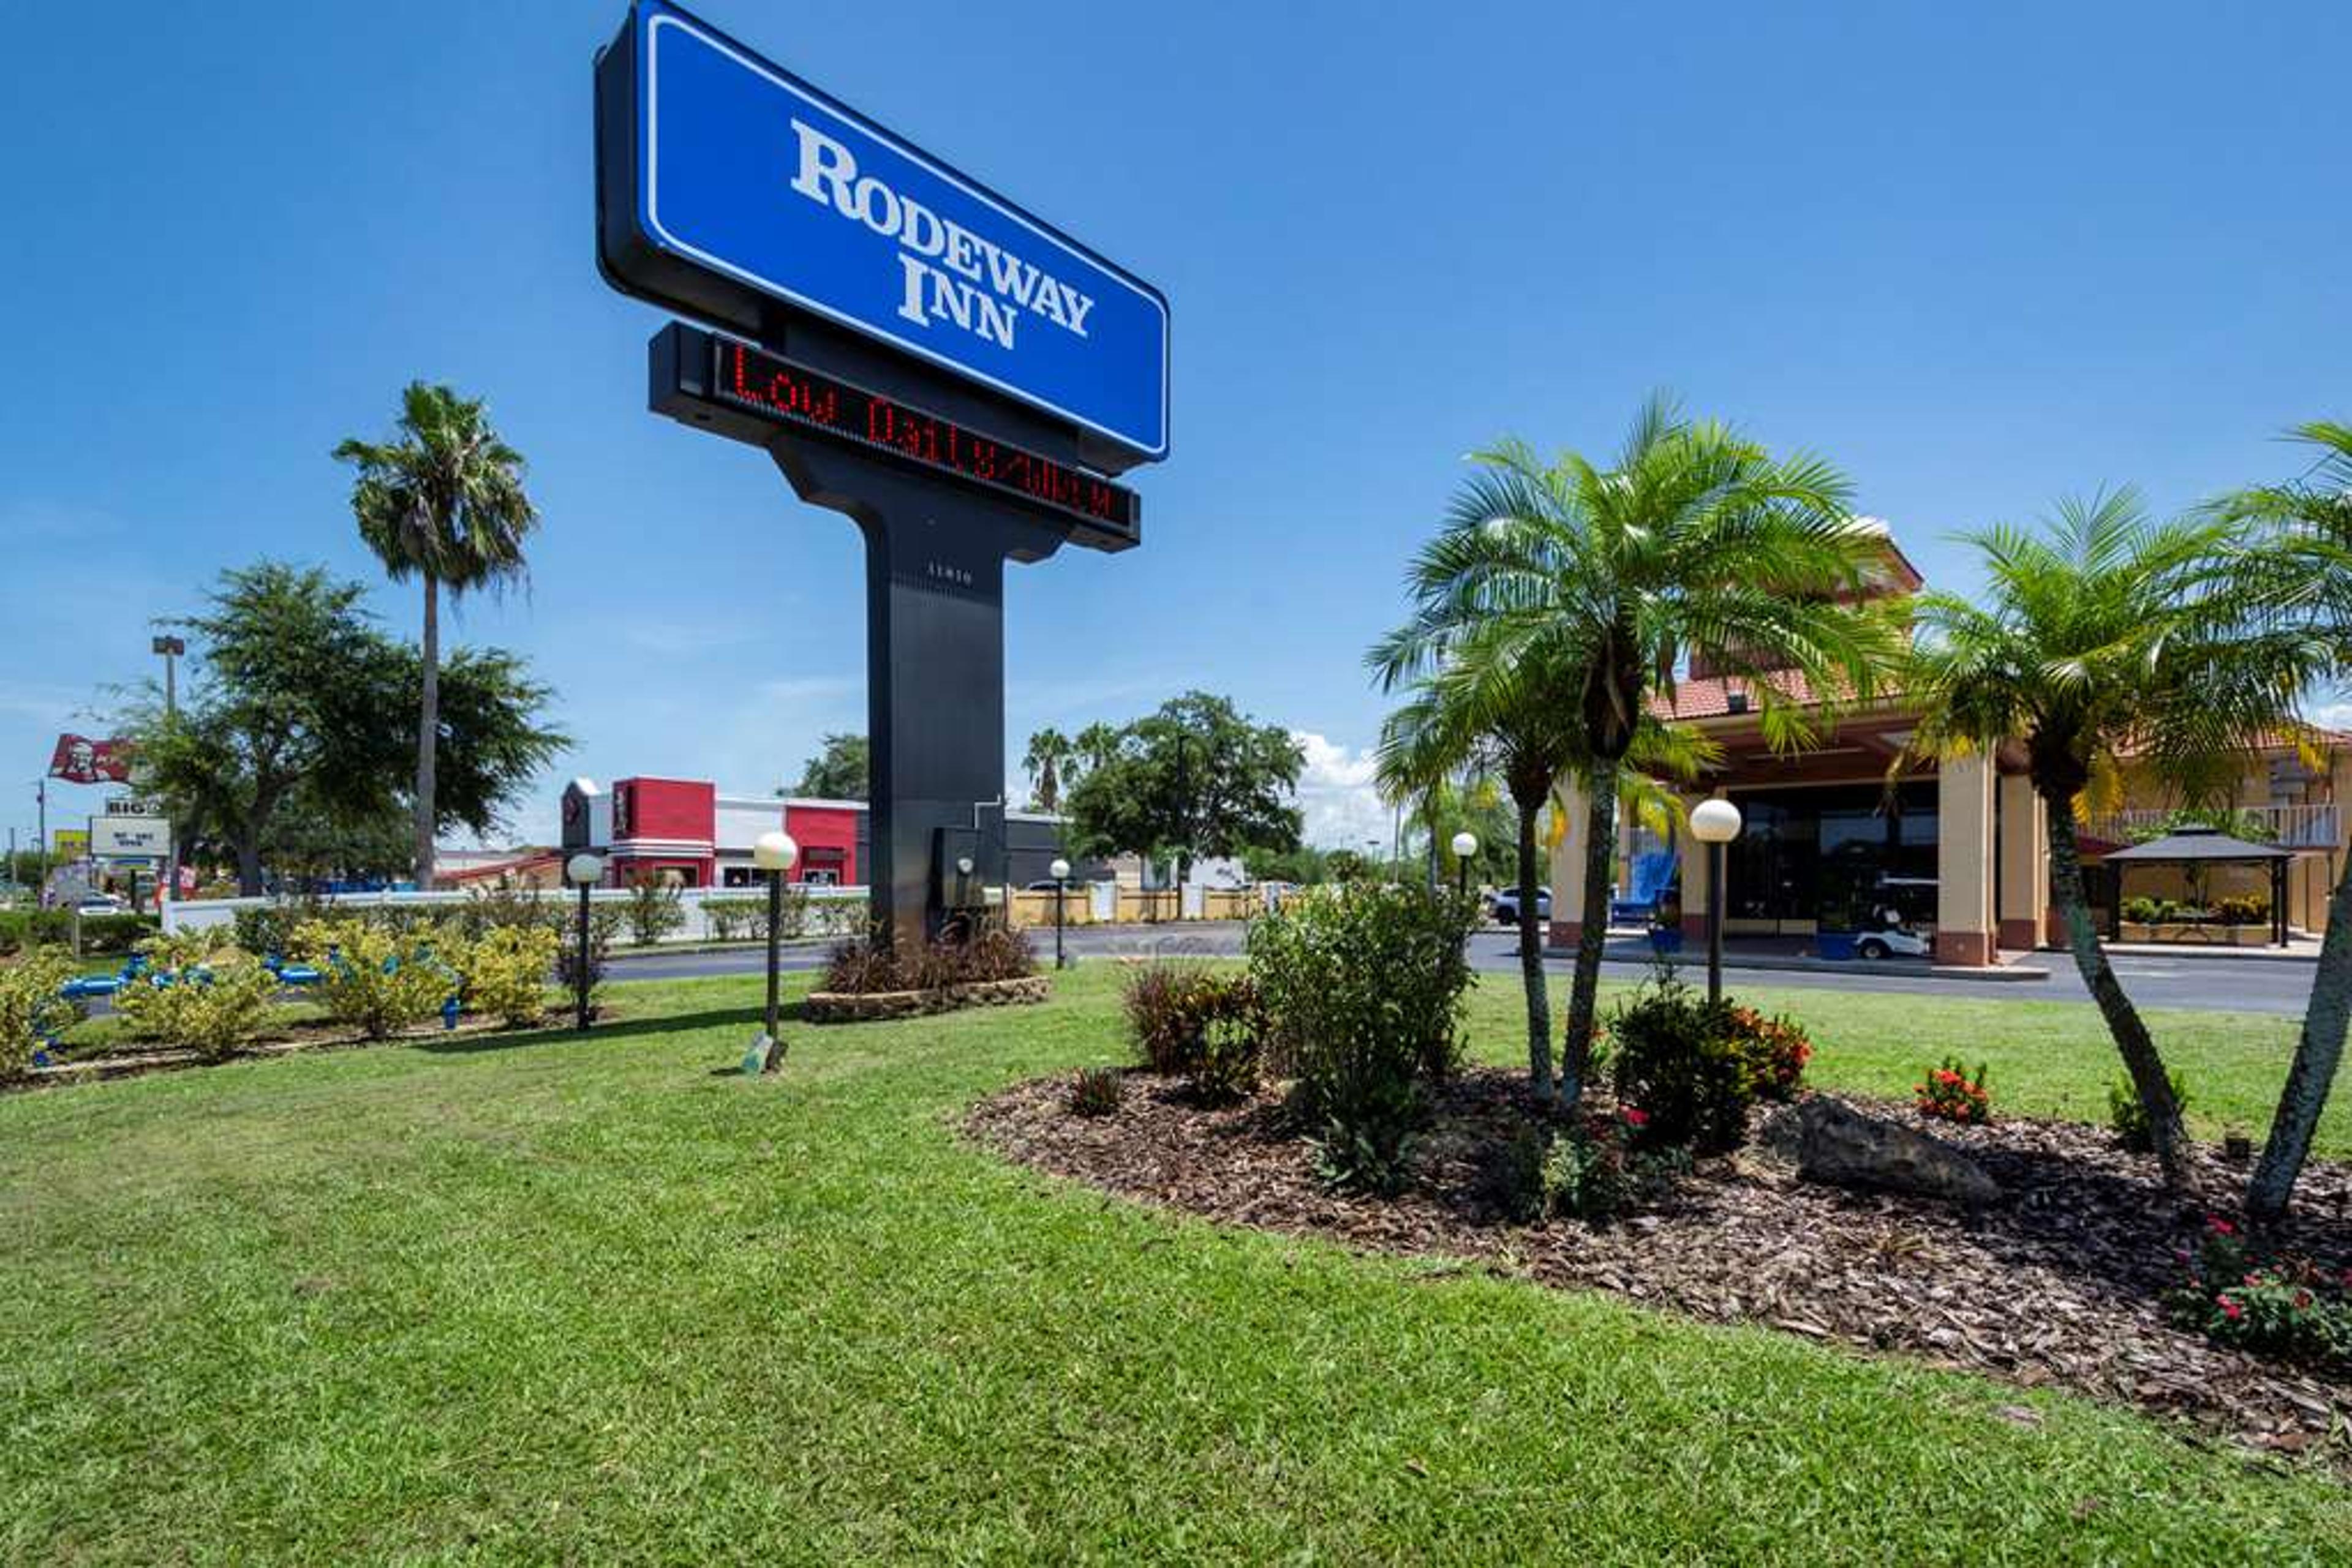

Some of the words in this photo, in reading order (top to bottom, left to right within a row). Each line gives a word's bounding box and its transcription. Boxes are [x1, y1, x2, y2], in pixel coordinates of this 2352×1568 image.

[791, 118, 1094, 337] RODEWAY
[897, 252, 1017, 350] INN
[110, 801, 146, 814] BIG
